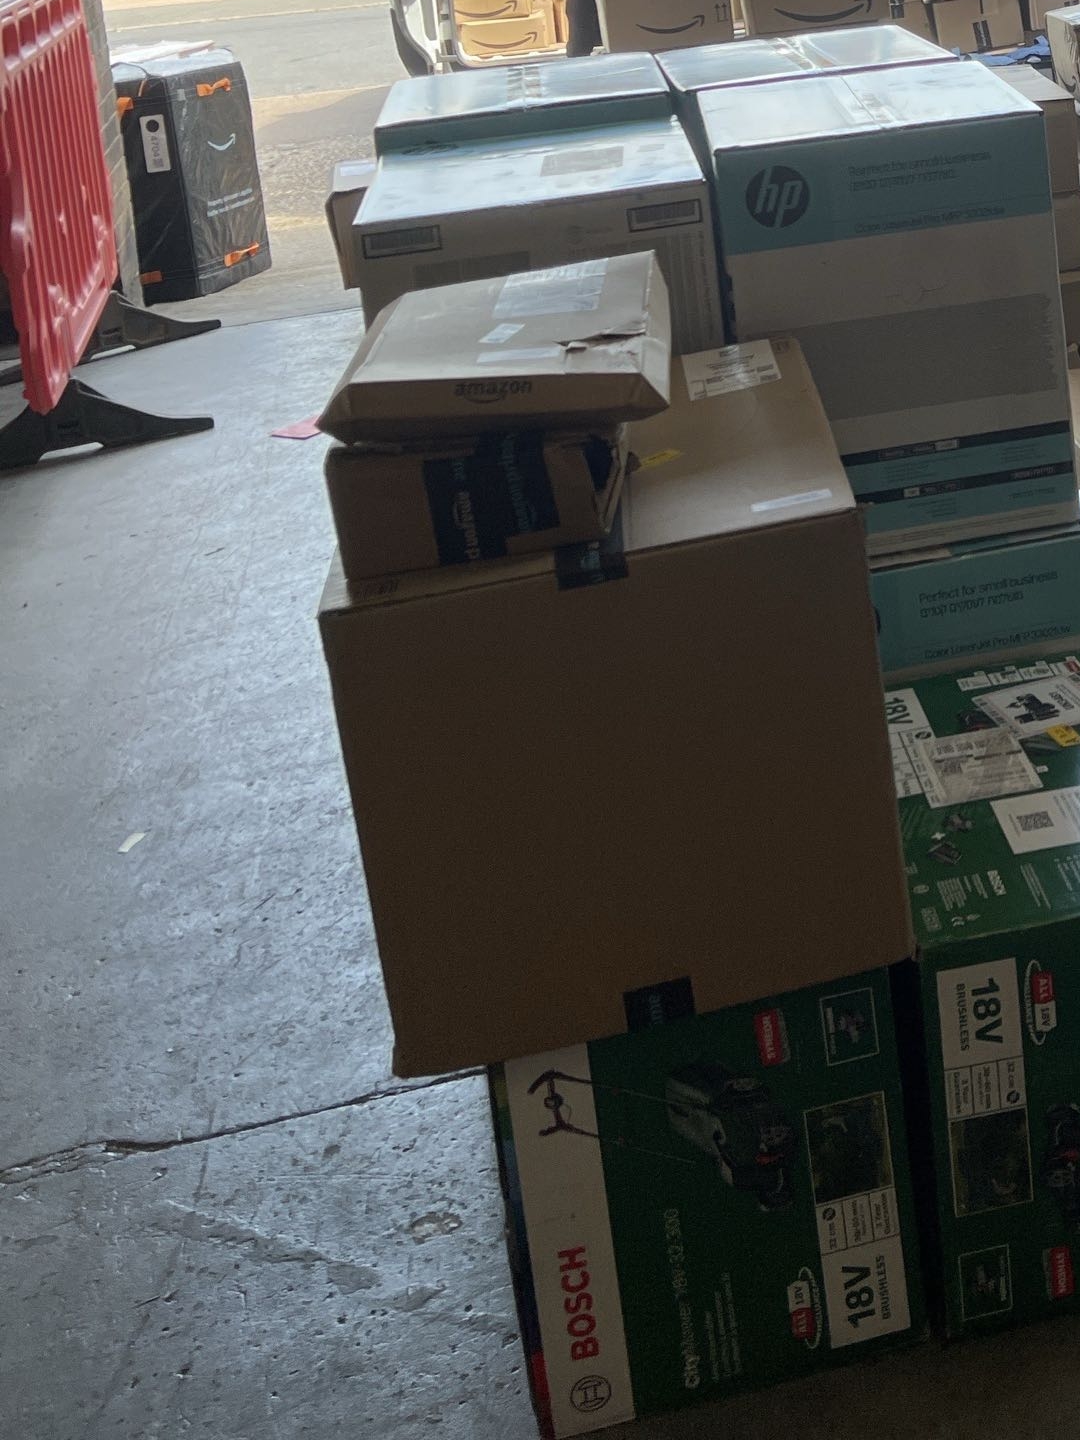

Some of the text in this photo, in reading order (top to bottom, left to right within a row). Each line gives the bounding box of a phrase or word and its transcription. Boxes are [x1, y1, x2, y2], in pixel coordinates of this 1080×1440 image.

[754, 165, 803, 228] hp
[455, 379, 532, 401] amazon
[955, 983, 971, 1053] BRUSHLESS
[971, 976, 1004, 1045] 18V
[557, 1245, 600, 1361] BOSCH
[841, 1265, 876, 1329] 18V
[875, 1255, 891, 1321] BRUSHLESS
